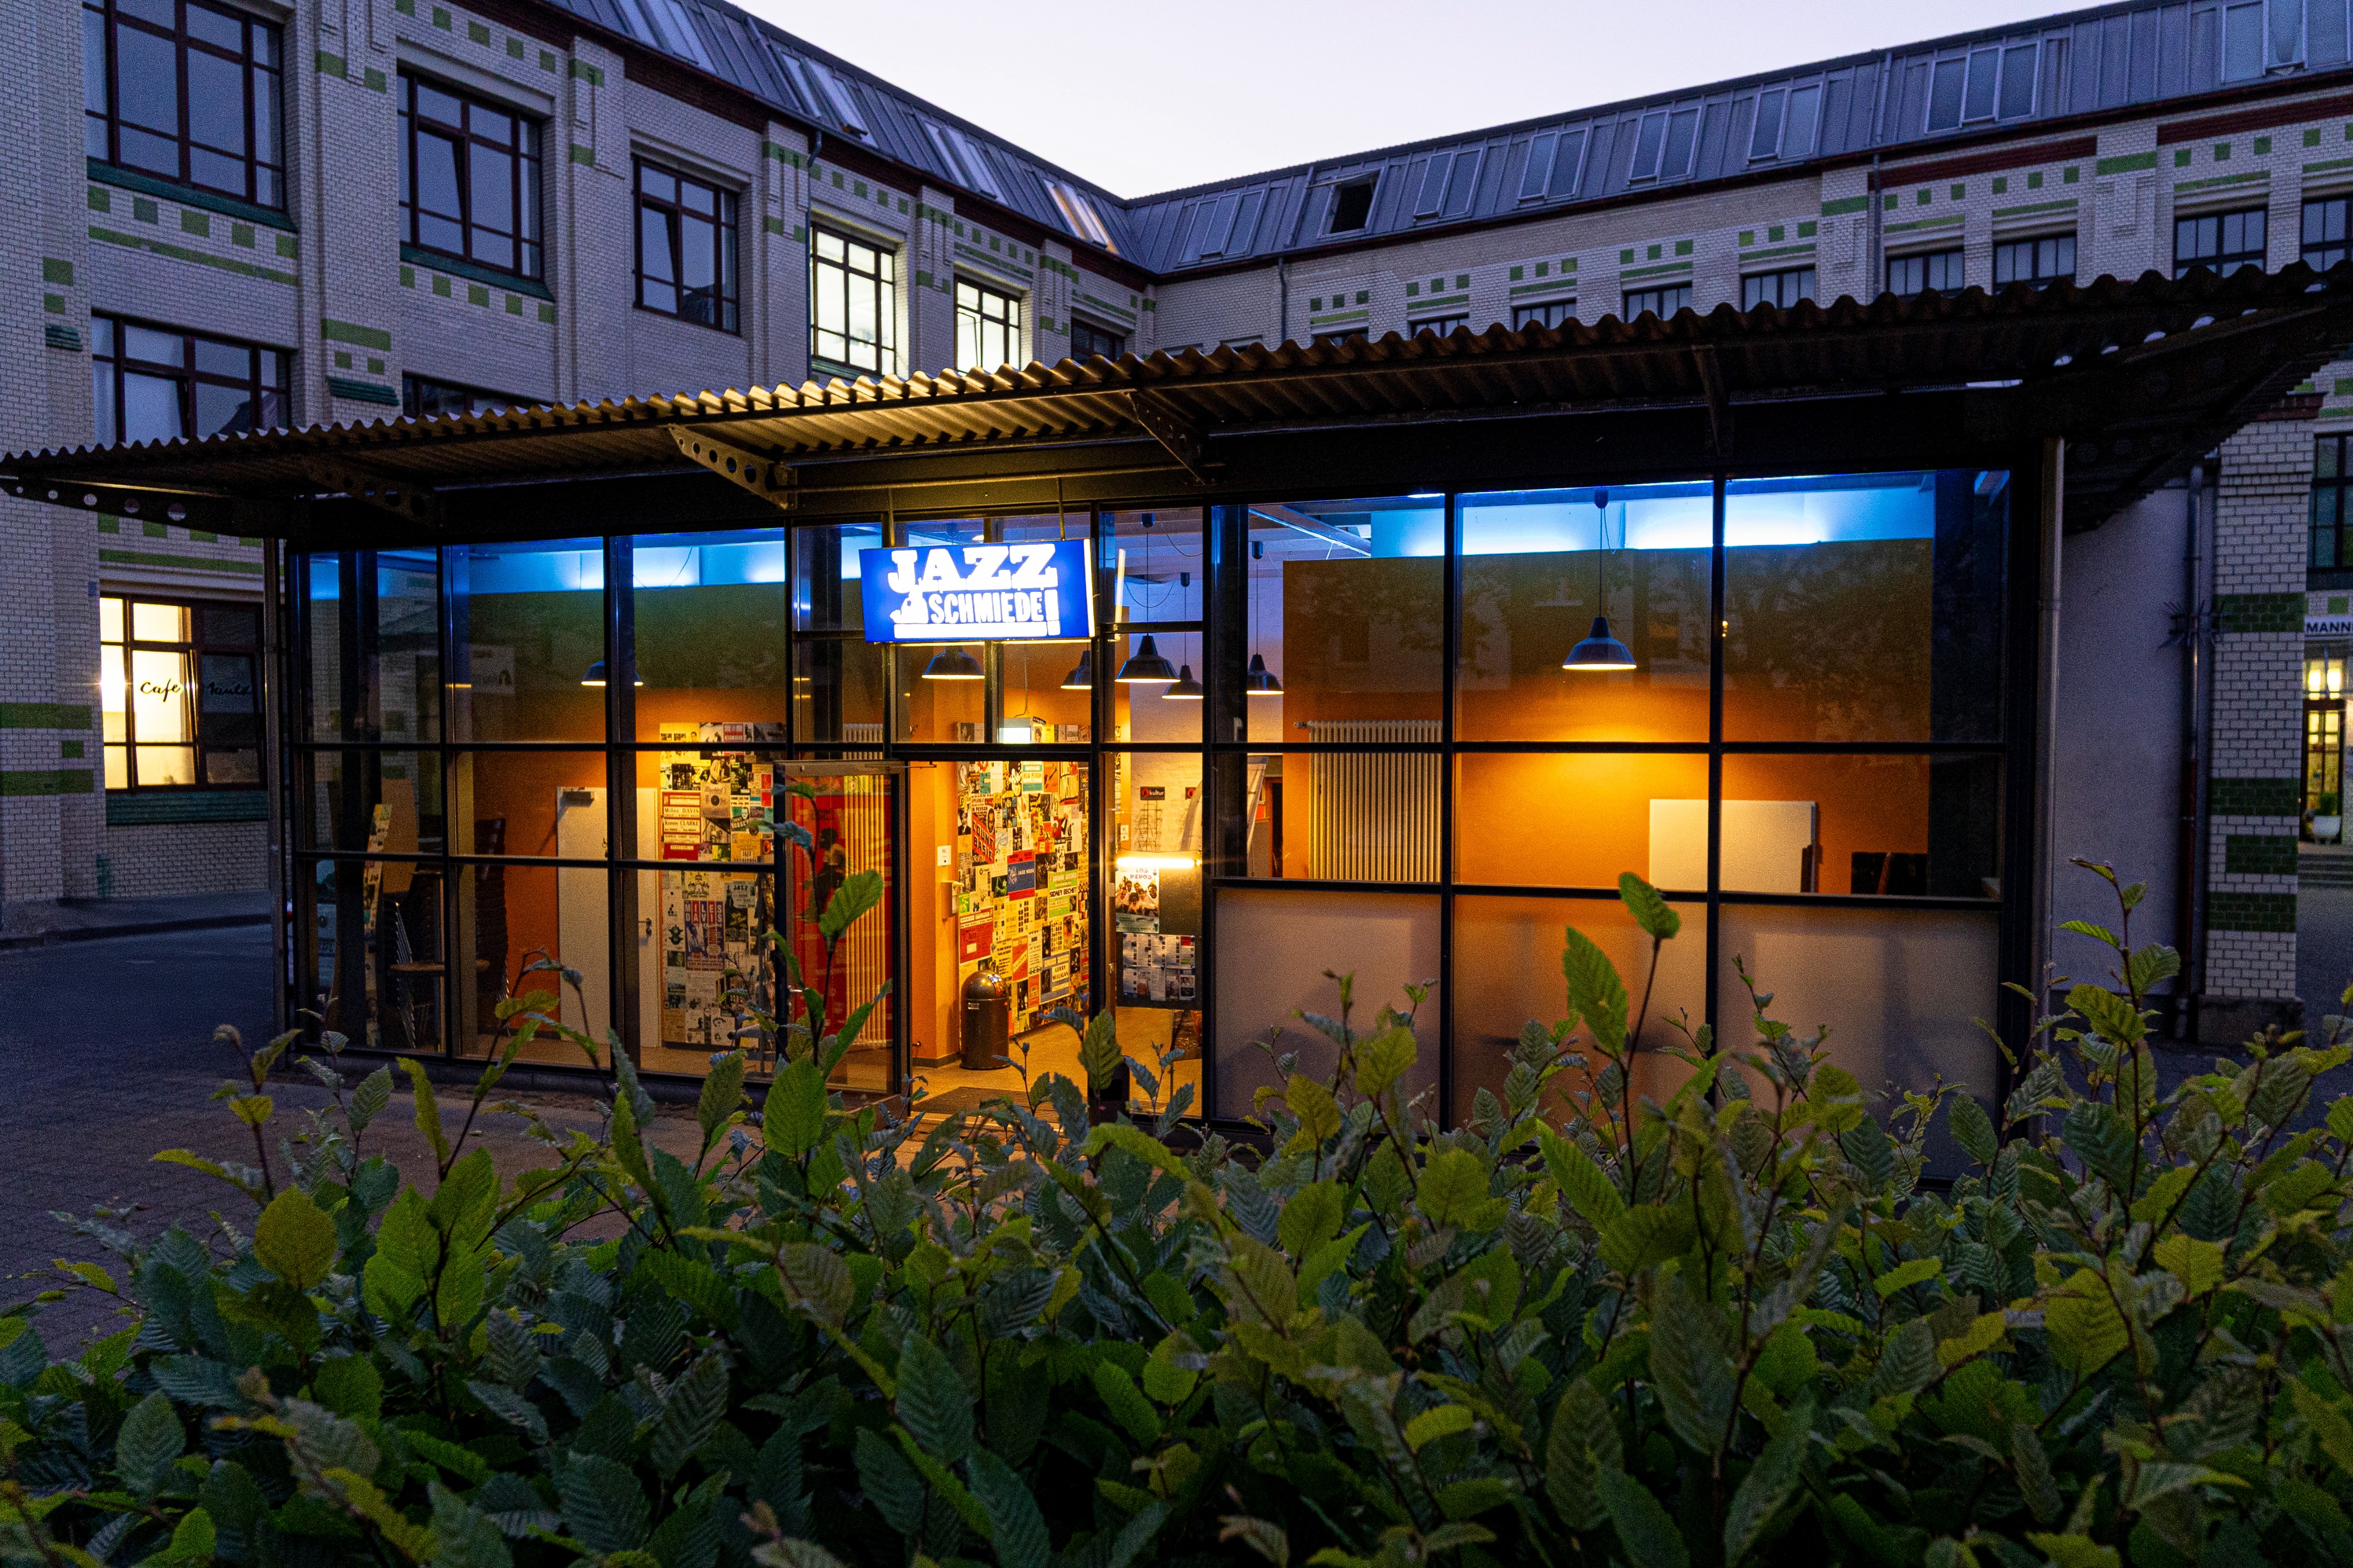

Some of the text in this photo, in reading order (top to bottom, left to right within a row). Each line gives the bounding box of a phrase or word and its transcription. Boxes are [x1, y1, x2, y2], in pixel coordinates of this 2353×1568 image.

[888, 544, 1058, 593] JAZZ
[929, 590, 1044, 624] SCHMIEDE
[2306, 621, 2353, 633] MANN
[973, 819, 994, 848] COUNT
[974, 834, 993, 862] BASIE
[685, 903, 723, 913] MILES
[686, 912, 723, 923] DAVIS
[1052, 972, 1069, 980] MULLIGAN
